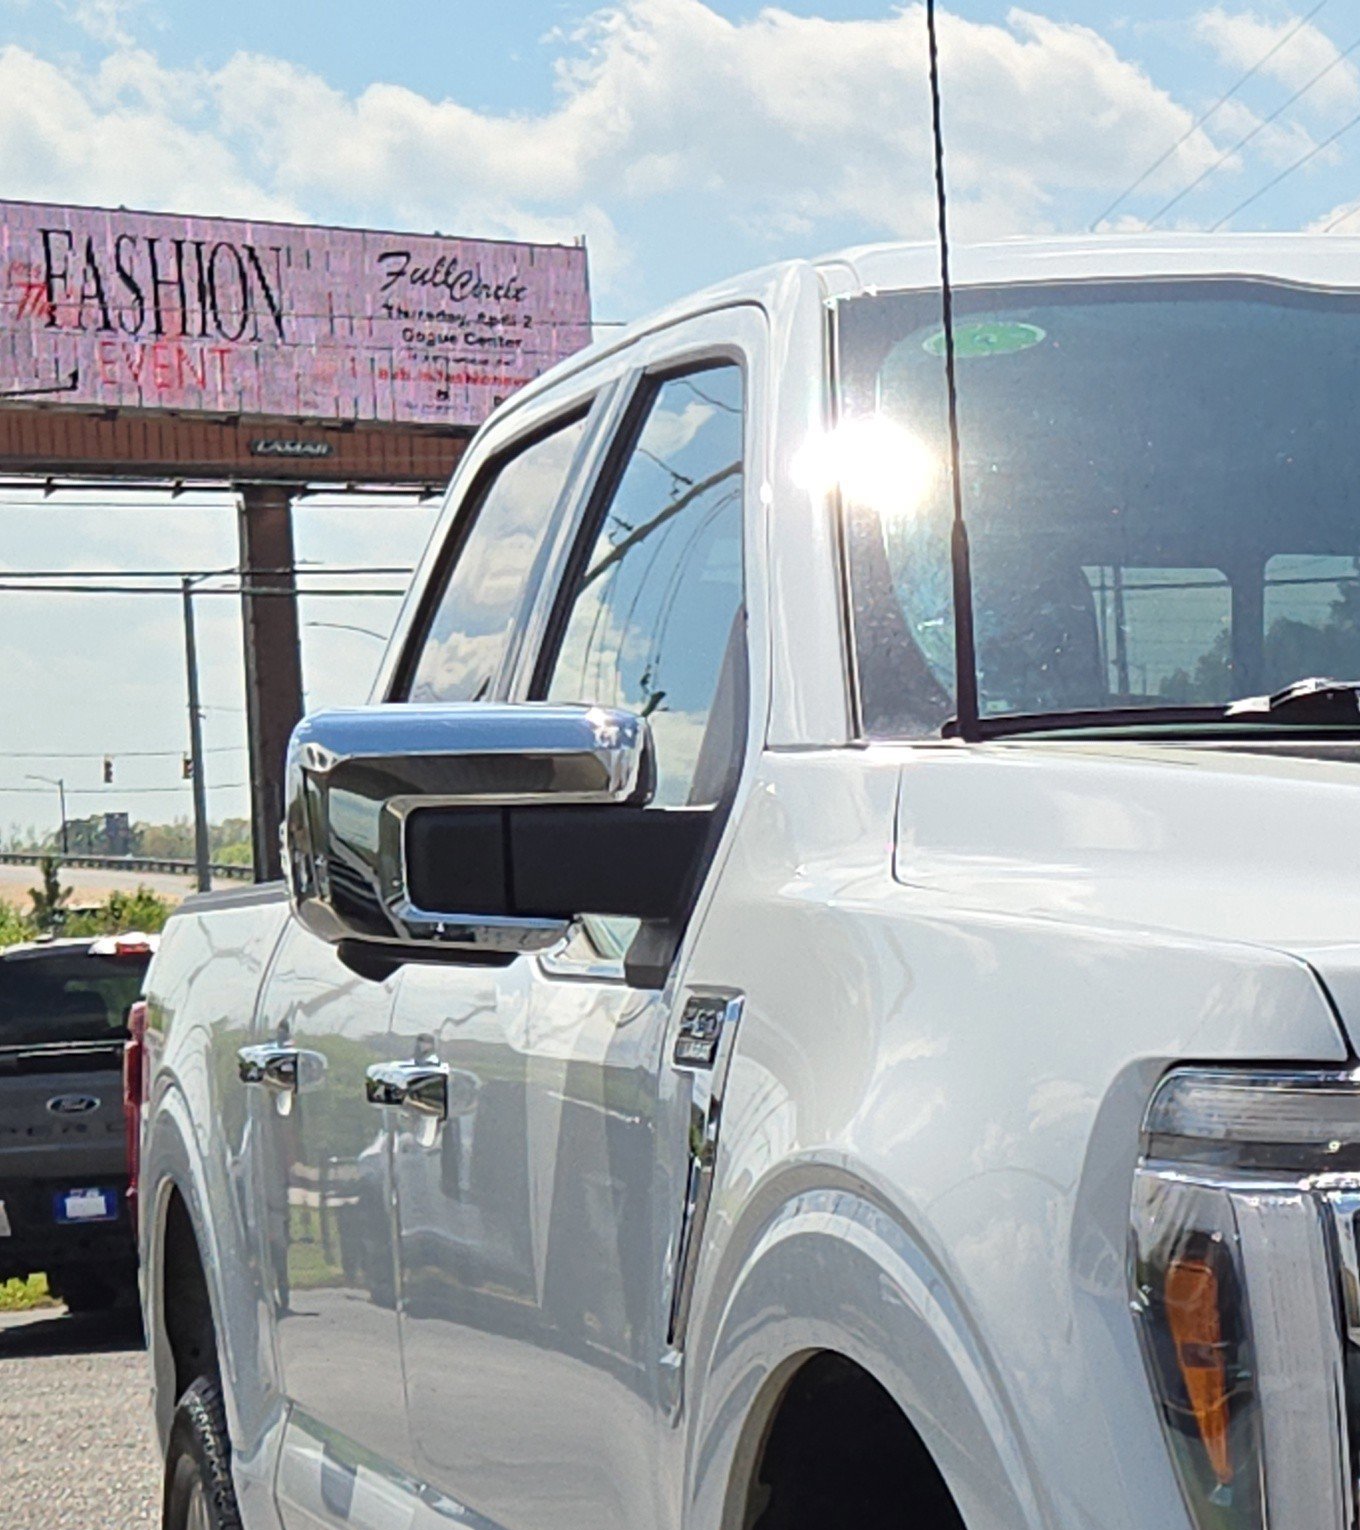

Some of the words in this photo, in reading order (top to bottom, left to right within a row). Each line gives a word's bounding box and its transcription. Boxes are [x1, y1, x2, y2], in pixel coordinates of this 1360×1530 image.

[38, 228, 284, 346] FASHION
[100, 340, 232, 393] EVENT
[463, 332, 523, 348] Center
